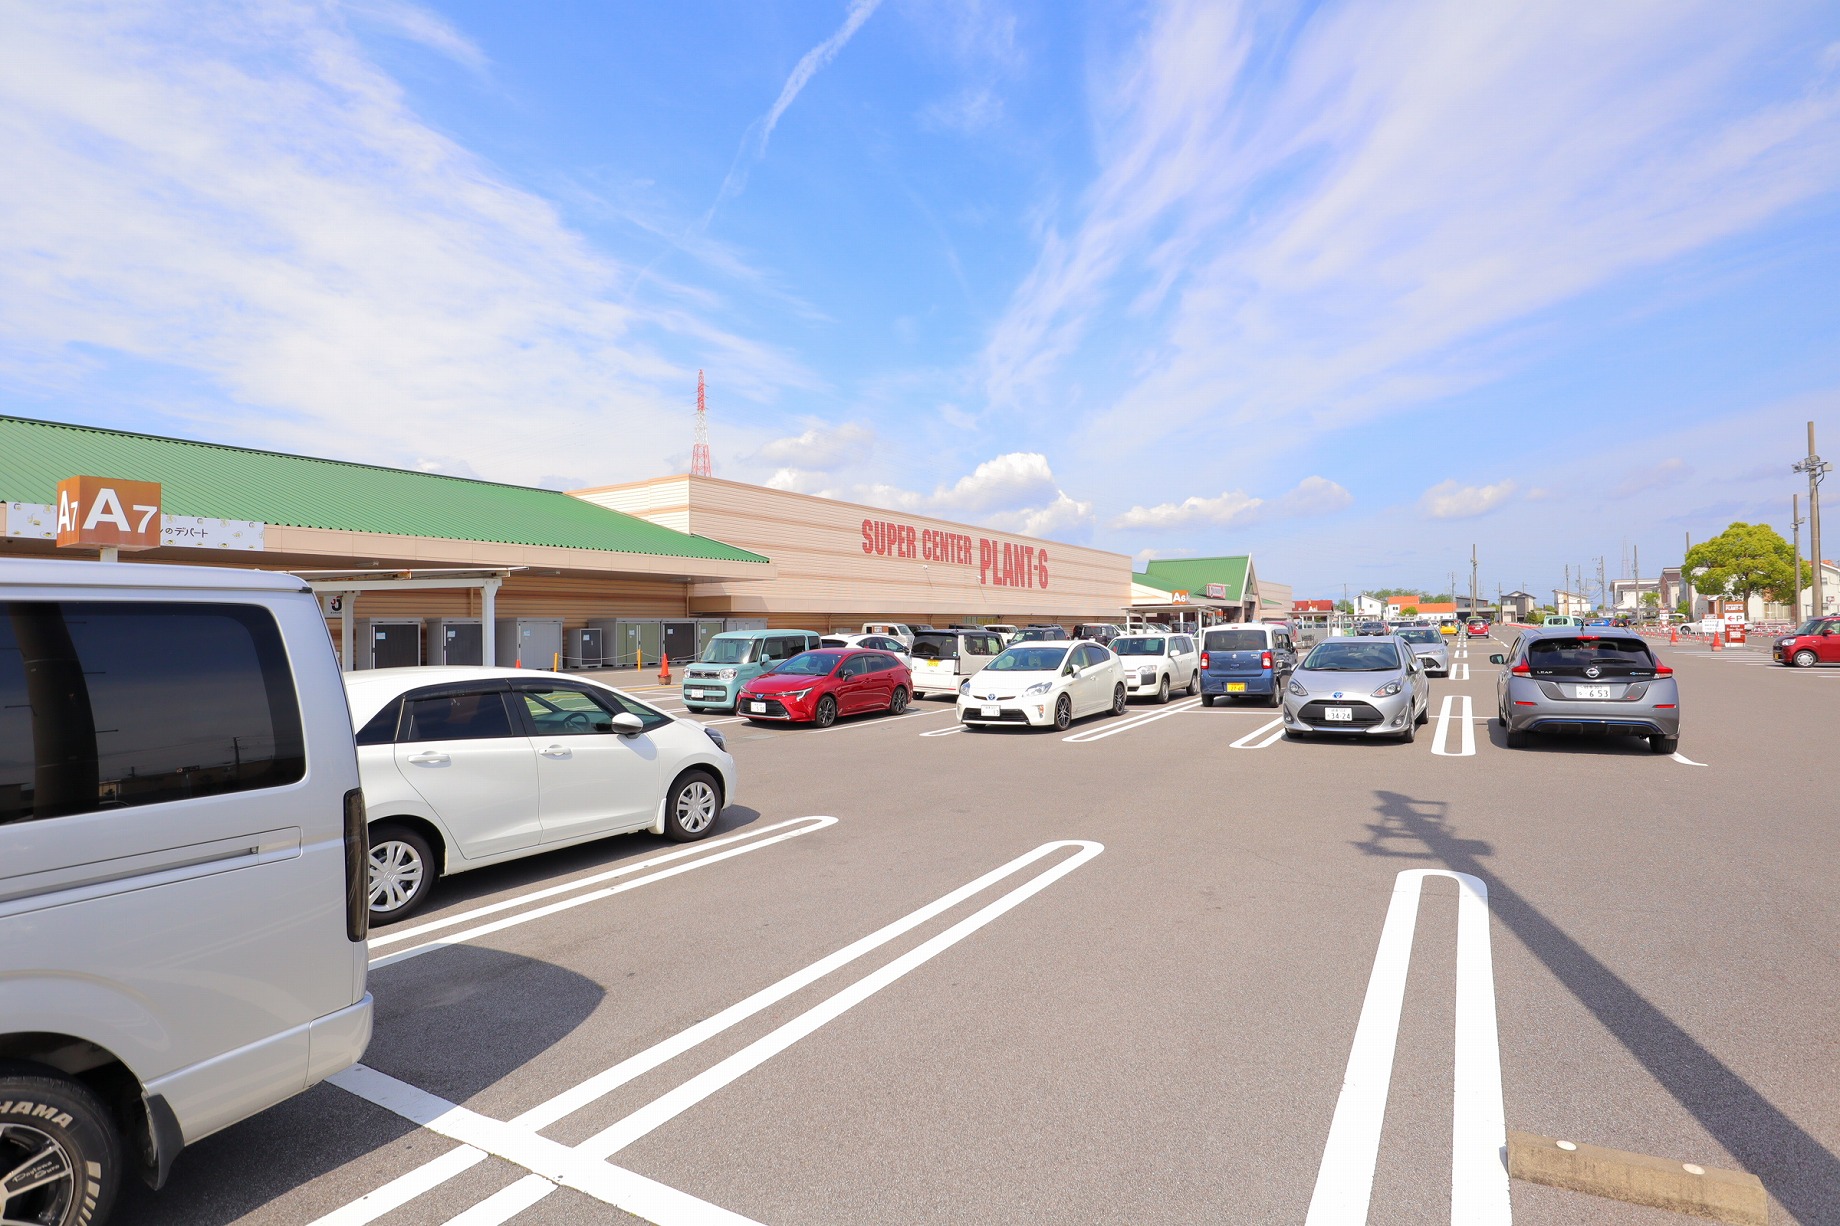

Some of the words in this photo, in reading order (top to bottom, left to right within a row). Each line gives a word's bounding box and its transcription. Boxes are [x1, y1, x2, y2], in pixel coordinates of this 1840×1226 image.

[57, 490, 79, 534] A7
[82, 487, 158, 534] A7
[160, 527, 208, 538] のデパート
[861, 518, 917, 559] SUPER
[922, 528, 973, 565] CENTER
[979, 537, 1049, 589] PLANT-6
